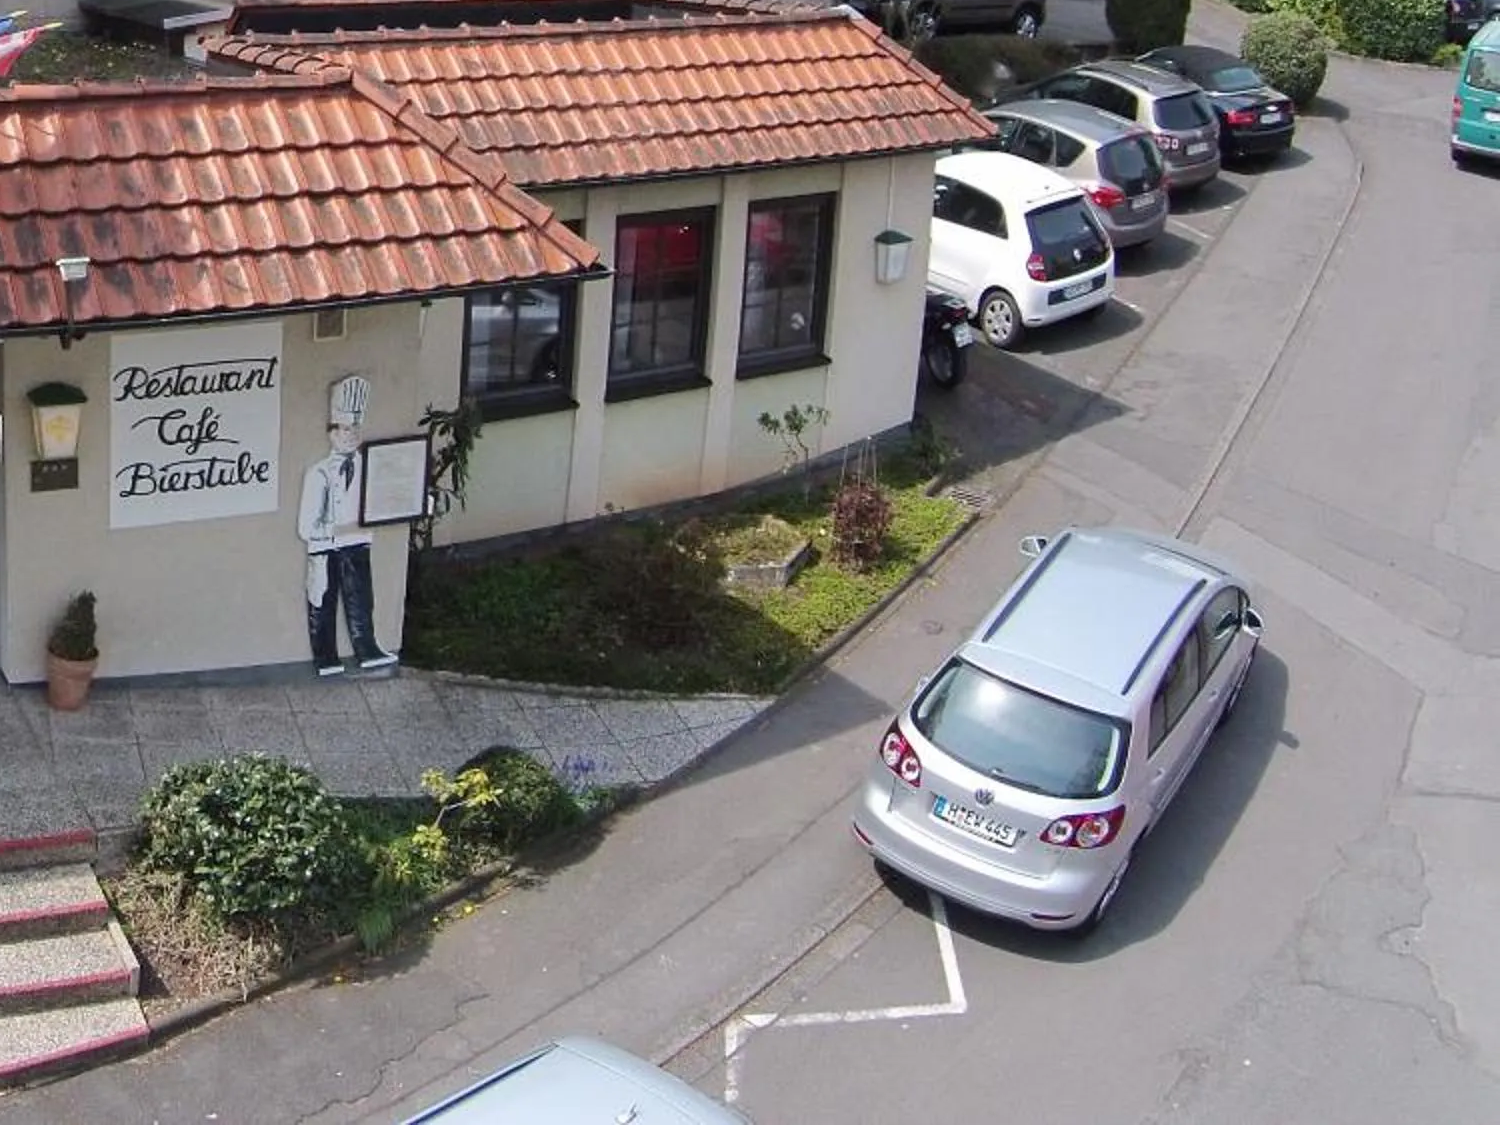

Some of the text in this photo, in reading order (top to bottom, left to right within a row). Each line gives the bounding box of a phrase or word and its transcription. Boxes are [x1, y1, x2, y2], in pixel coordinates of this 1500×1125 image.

[113, 356, 278, 402] Restaurant
[131, 406, 240, 456] Café
[115, 451, 270, 498] Bierstube
